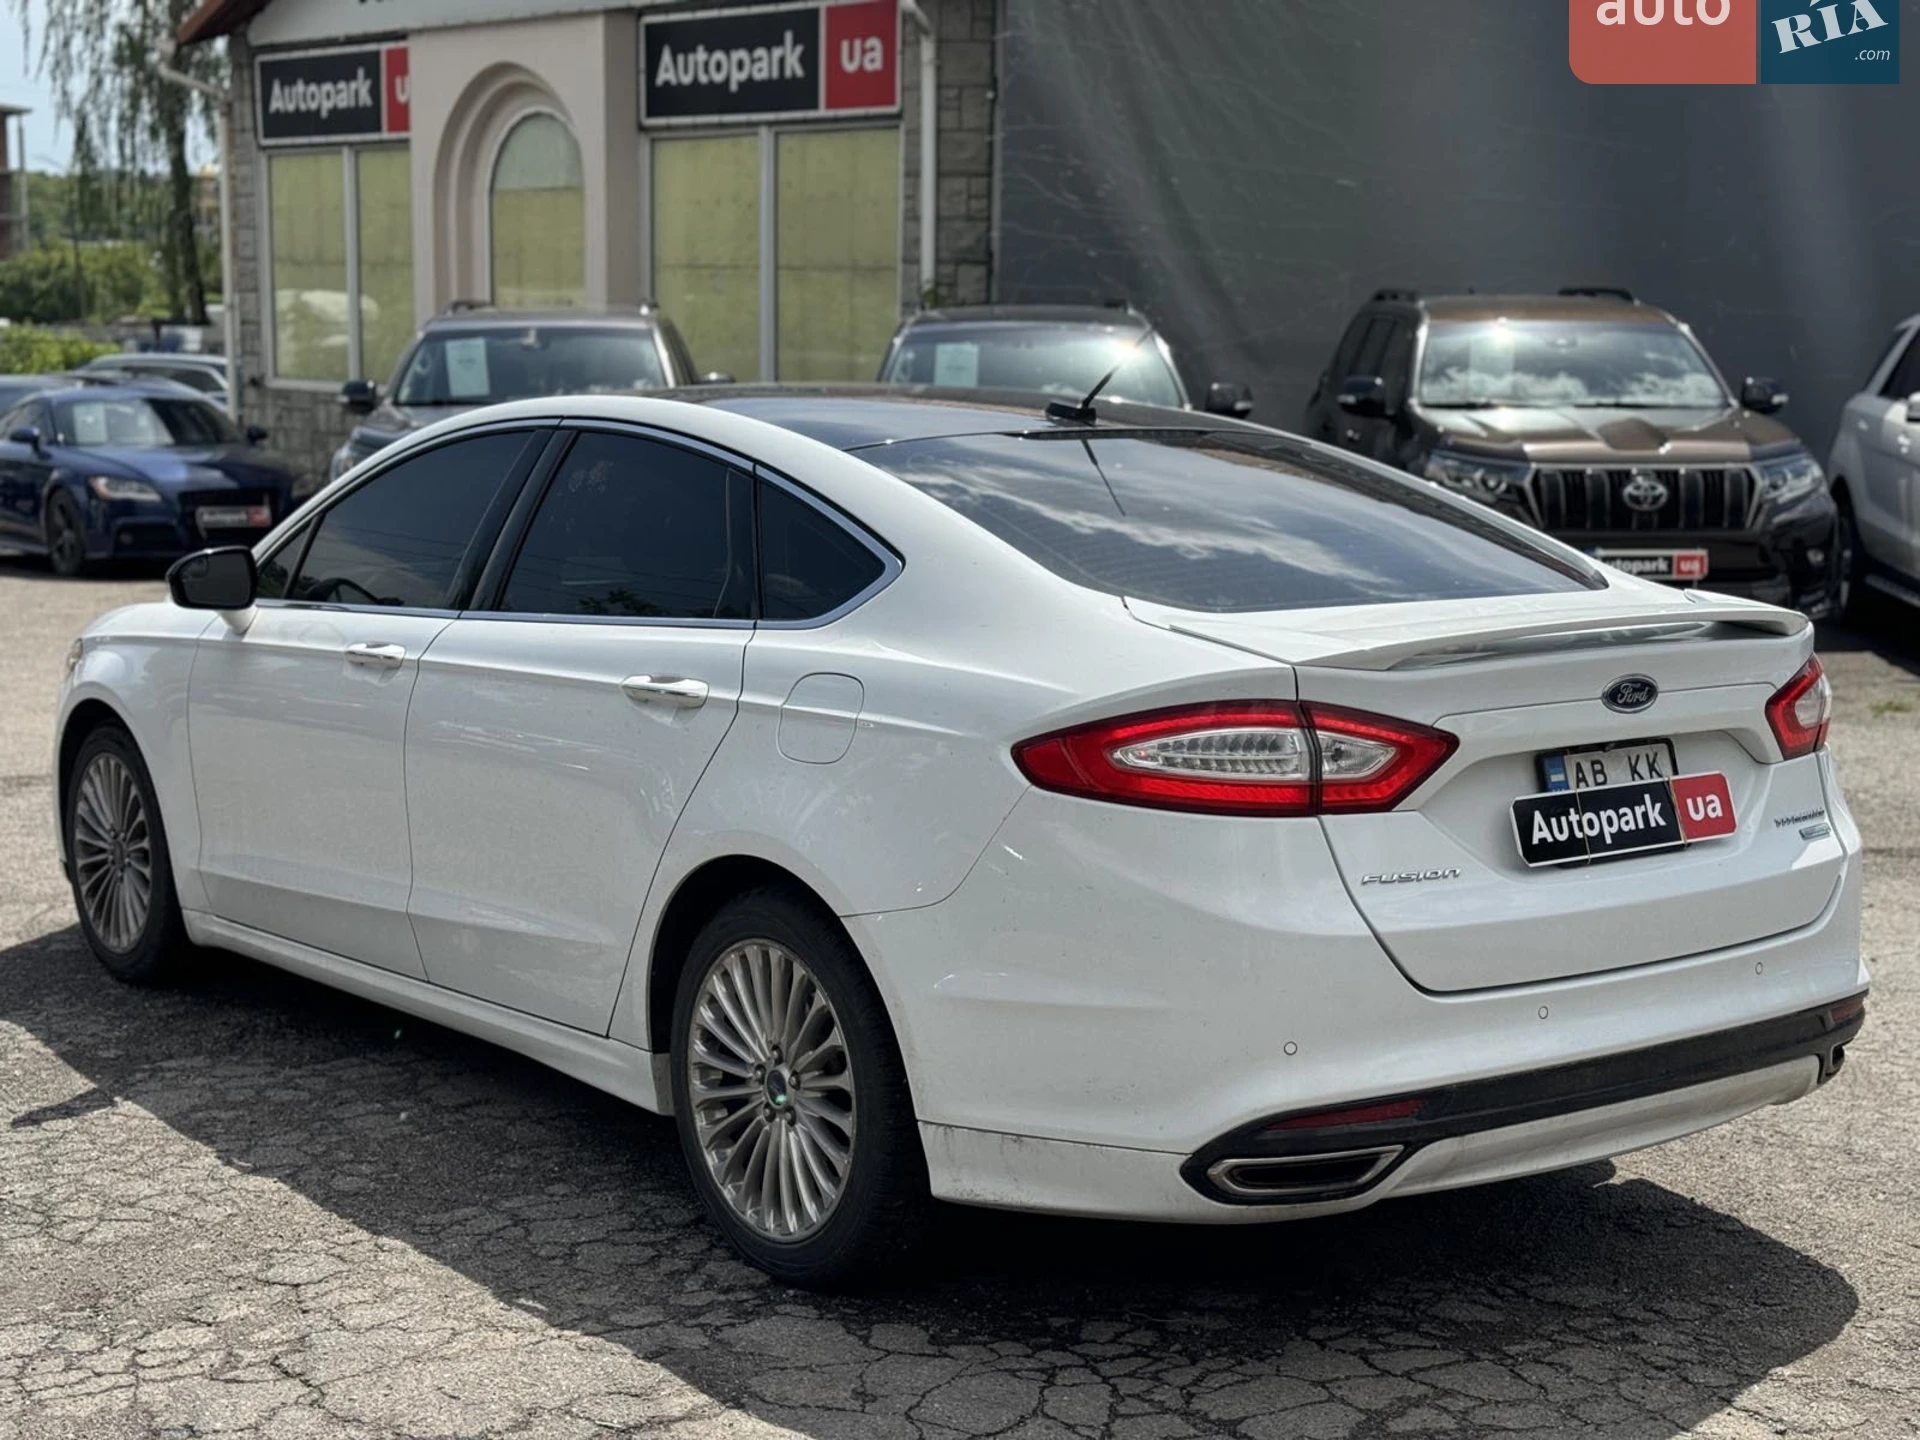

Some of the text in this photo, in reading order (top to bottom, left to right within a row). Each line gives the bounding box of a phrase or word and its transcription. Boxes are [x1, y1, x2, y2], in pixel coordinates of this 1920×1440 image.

[655, 29, 883, 93] Autopark ua
[269, 66, 410, 119] Autopark u
[1617, 682, 1651, 704] Ford
[1574, 751, 1664, 789] AB KK
[1532, 793, 1724, 845] Autopark ua
